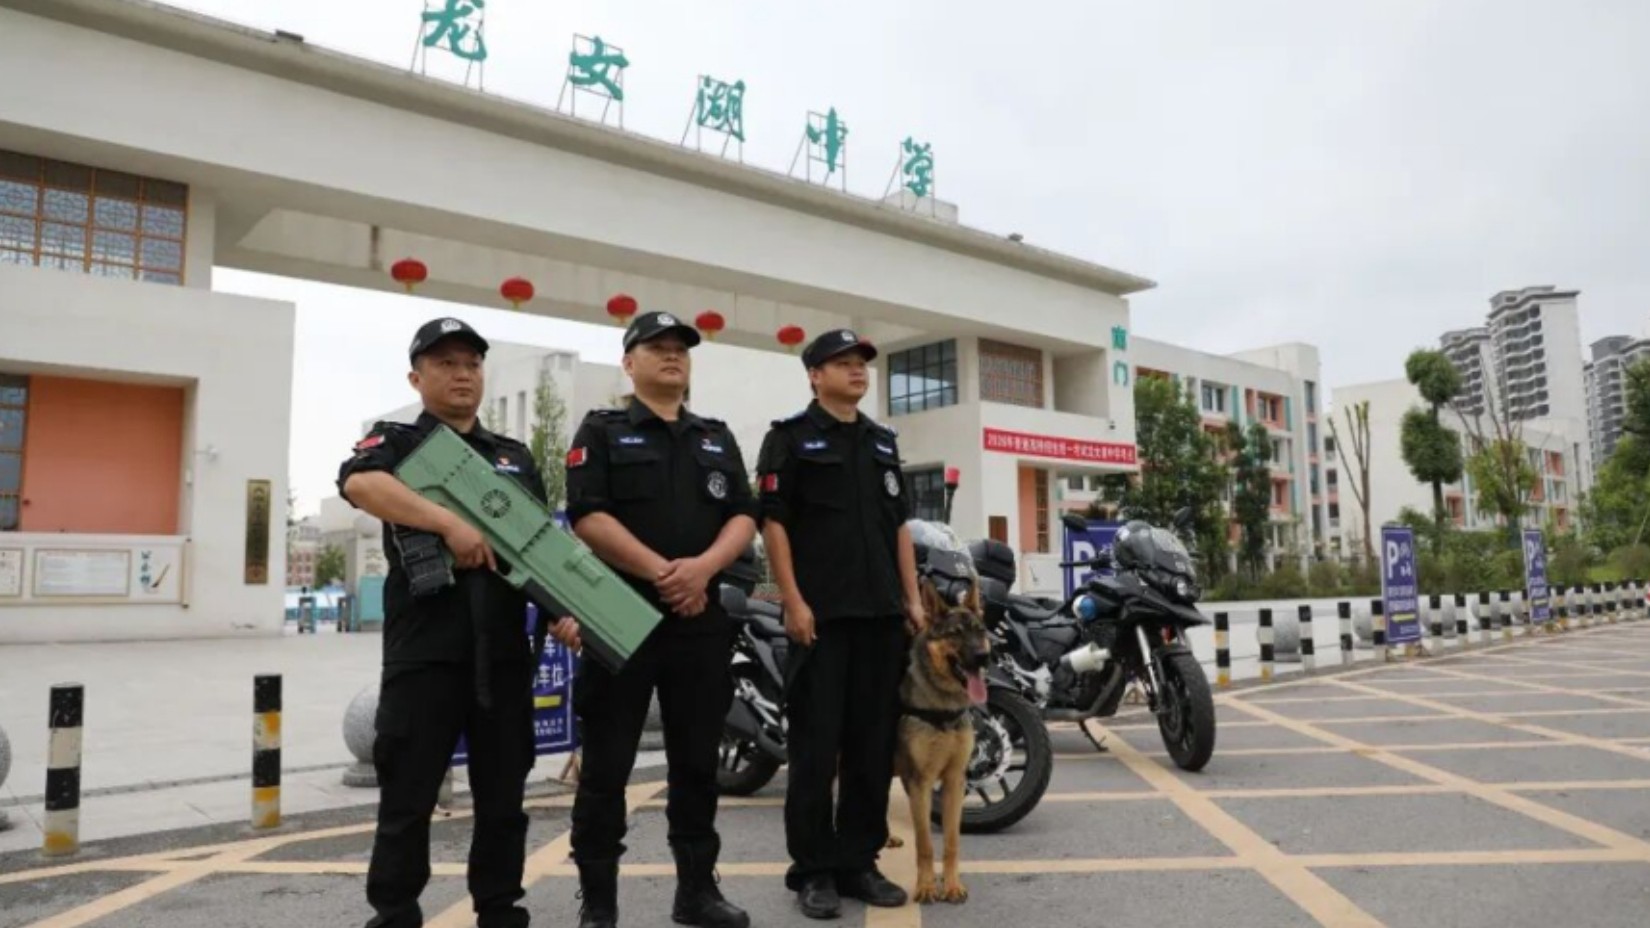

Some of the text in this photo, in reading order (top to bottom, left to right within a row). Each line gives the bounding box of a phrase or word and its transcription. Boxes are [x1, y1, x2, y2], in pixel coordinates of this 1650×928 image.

[421, 0, 934, 198] 龙女湖中学
[1386, 541, 1398, 578] P
